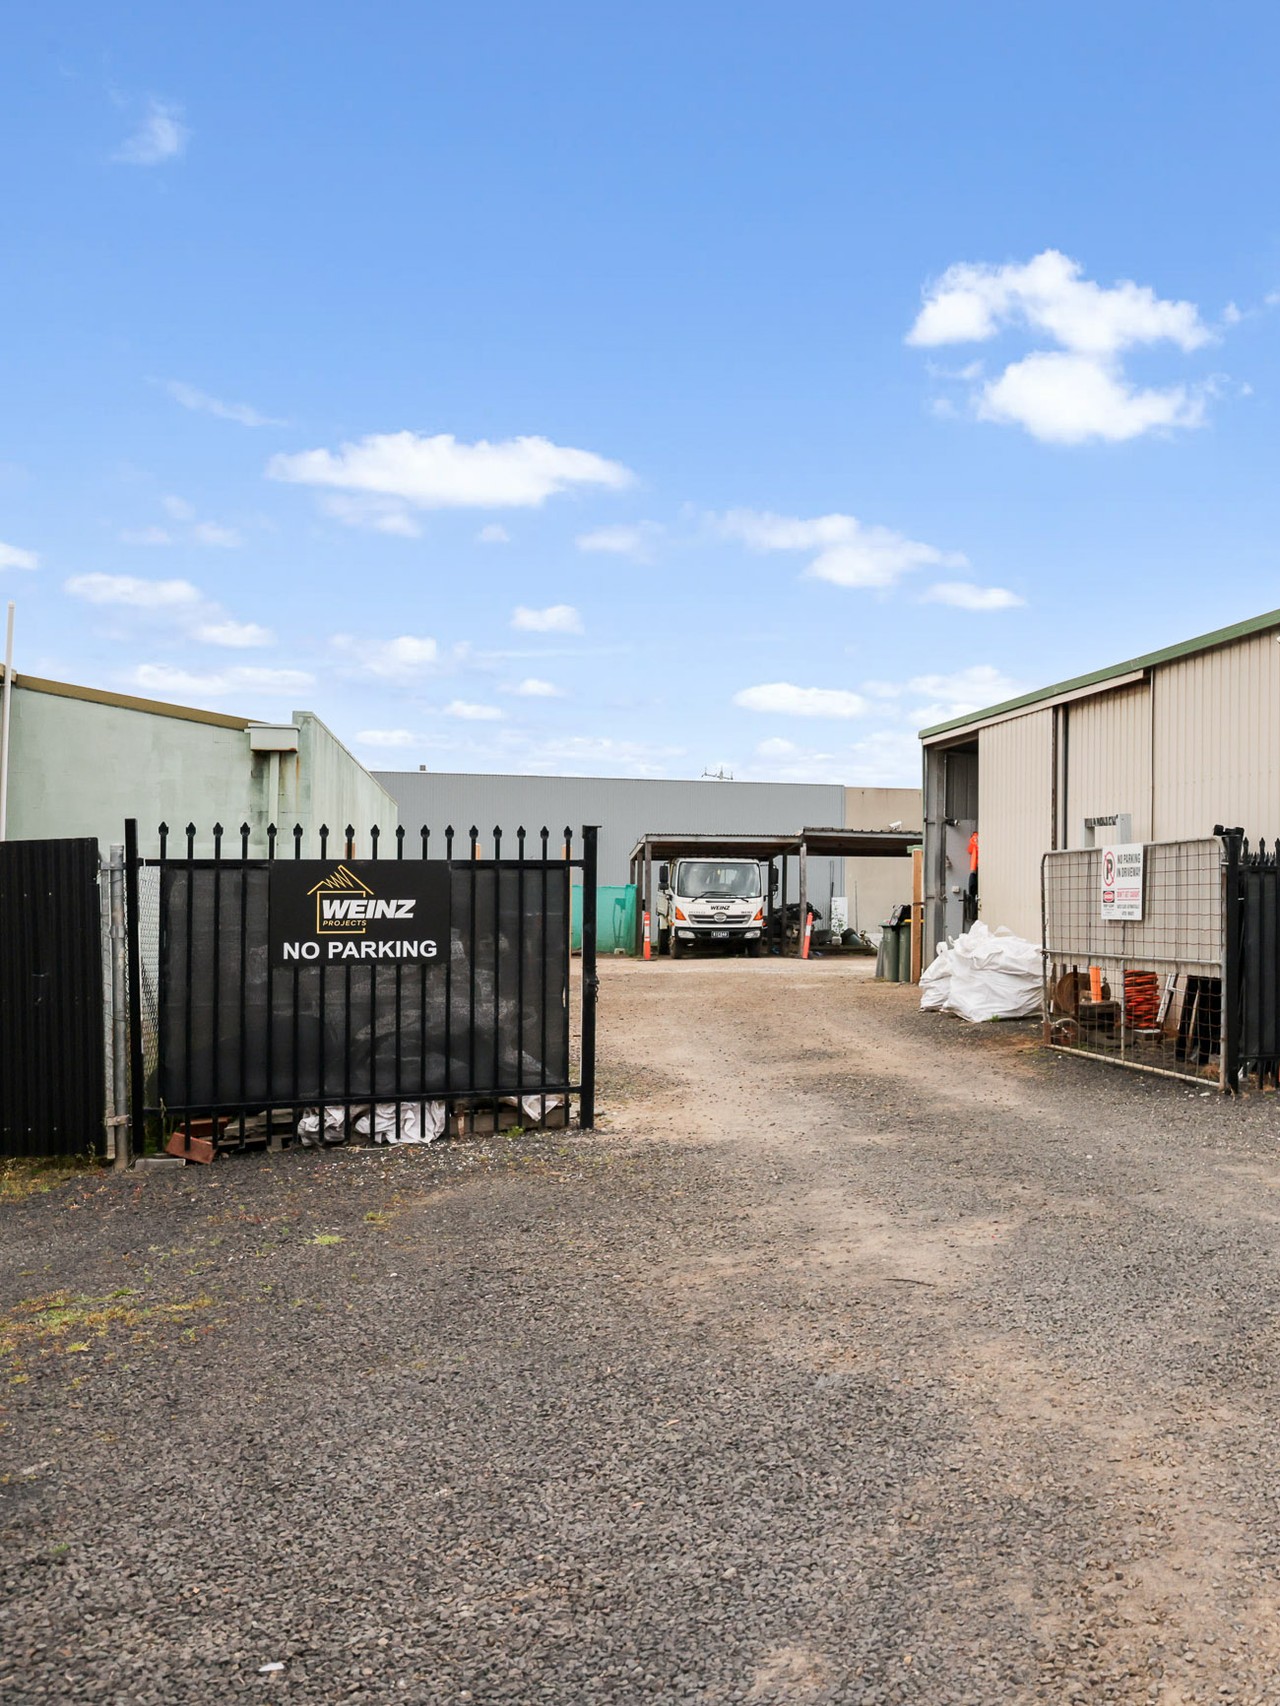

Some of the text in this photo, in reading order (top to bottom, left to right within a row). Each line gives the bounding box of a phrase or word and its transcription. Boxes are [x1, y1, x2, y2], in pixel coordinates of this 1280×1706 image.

[1117, 853, 1141, 864] NO PARKING
[322, 899, 416, 919] WEINZ
[283, 940, 437, 960] NO PARKING
